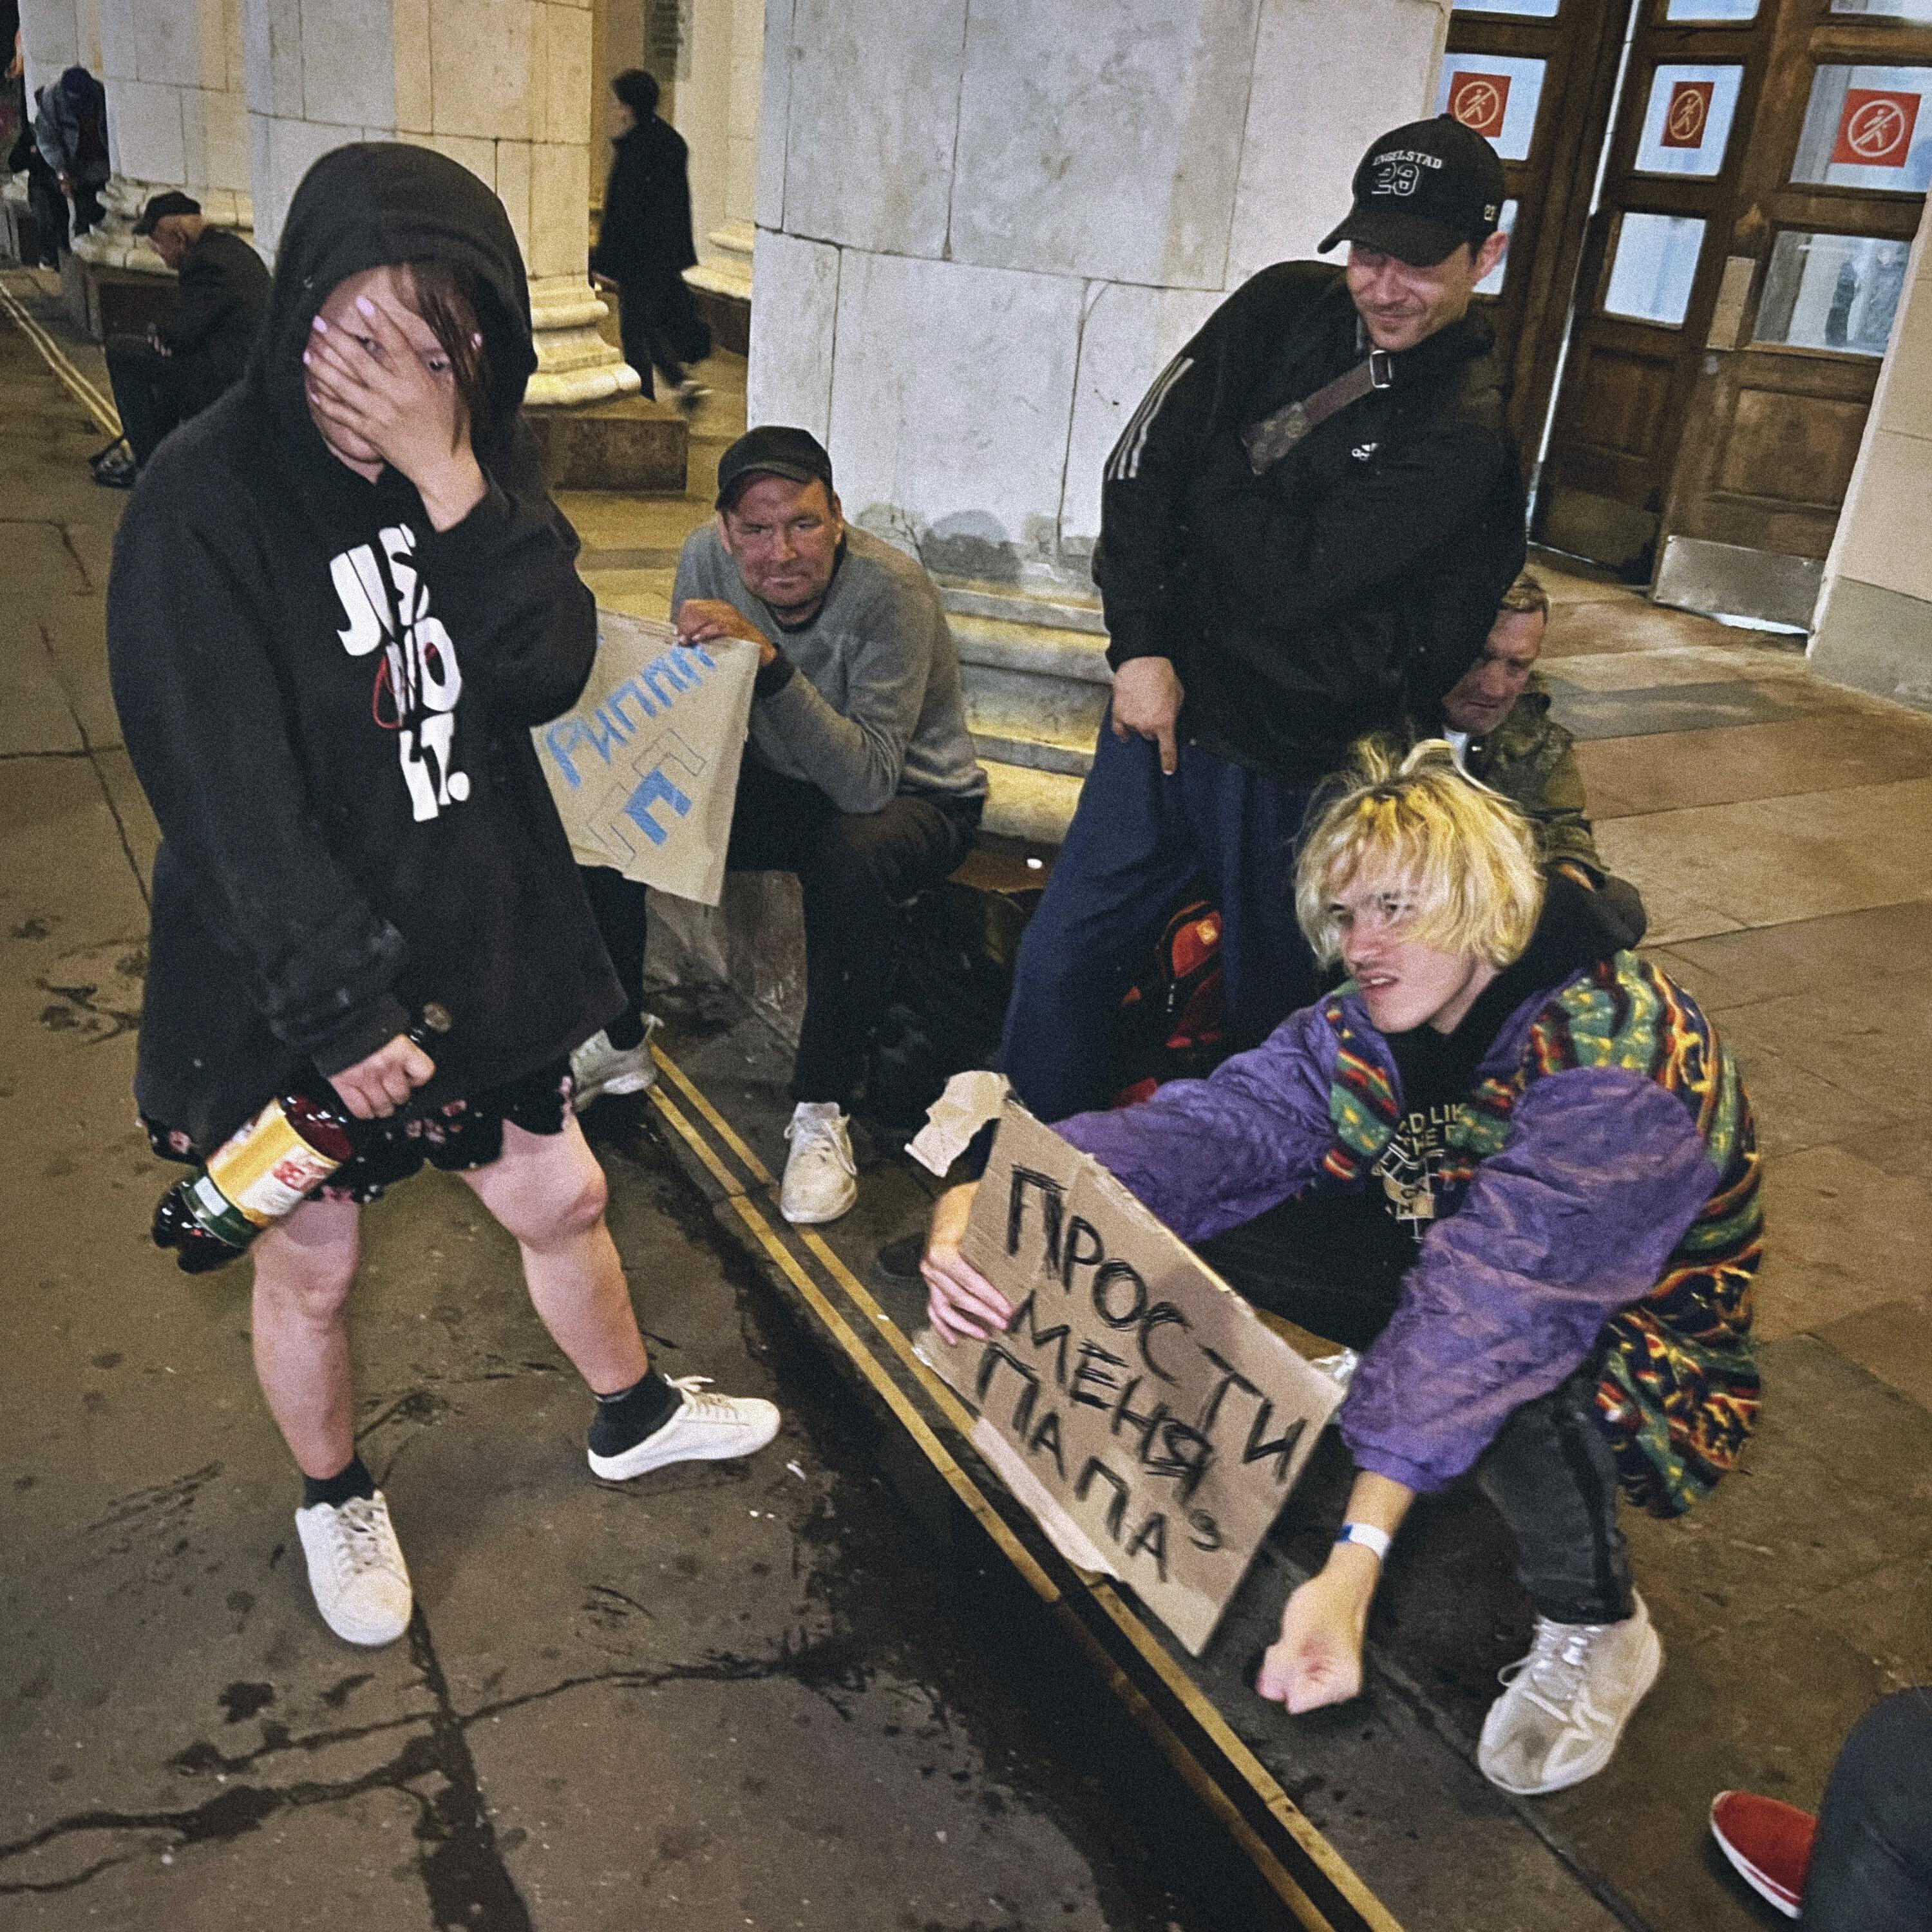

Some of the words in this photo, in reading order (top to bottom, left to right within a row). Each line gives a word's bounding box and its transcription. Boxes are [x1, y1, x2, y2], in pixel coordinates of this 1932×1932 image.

[1430, 1103, 1466, 1124] LIK
[1007, 1163, 1307, 1483] ПРОСТИ
[976, 1341, 1168, 1582] ПАПА
